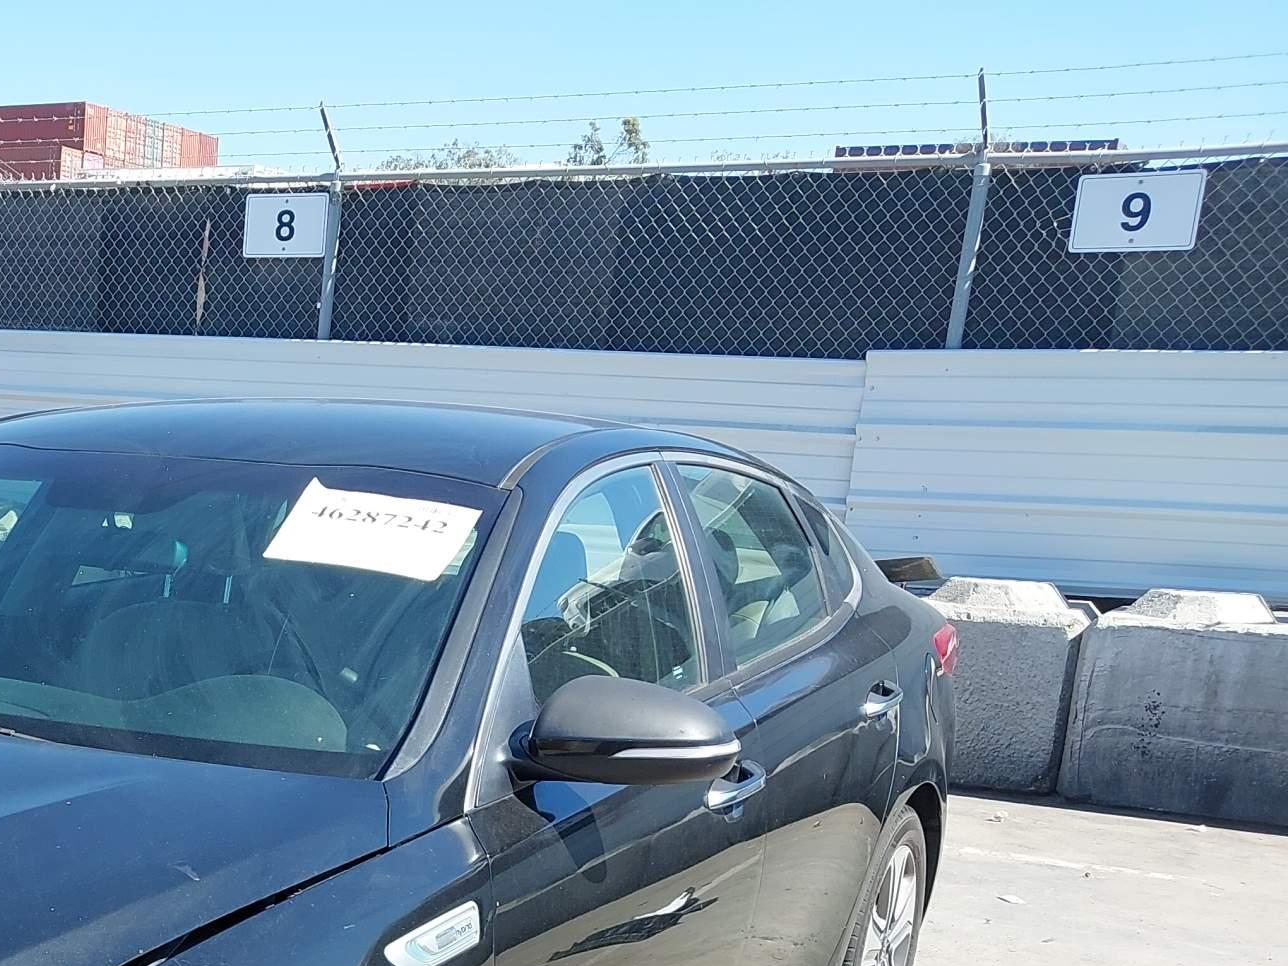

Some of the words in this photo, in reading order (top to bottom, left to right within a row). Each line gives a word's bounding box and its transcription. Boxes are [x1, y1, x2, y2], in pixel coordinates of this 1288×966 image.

[275, 209, 295, 242] 8
[1120, 192, 1152, 232] 9
[312, 506, 448, 534] 46287242
